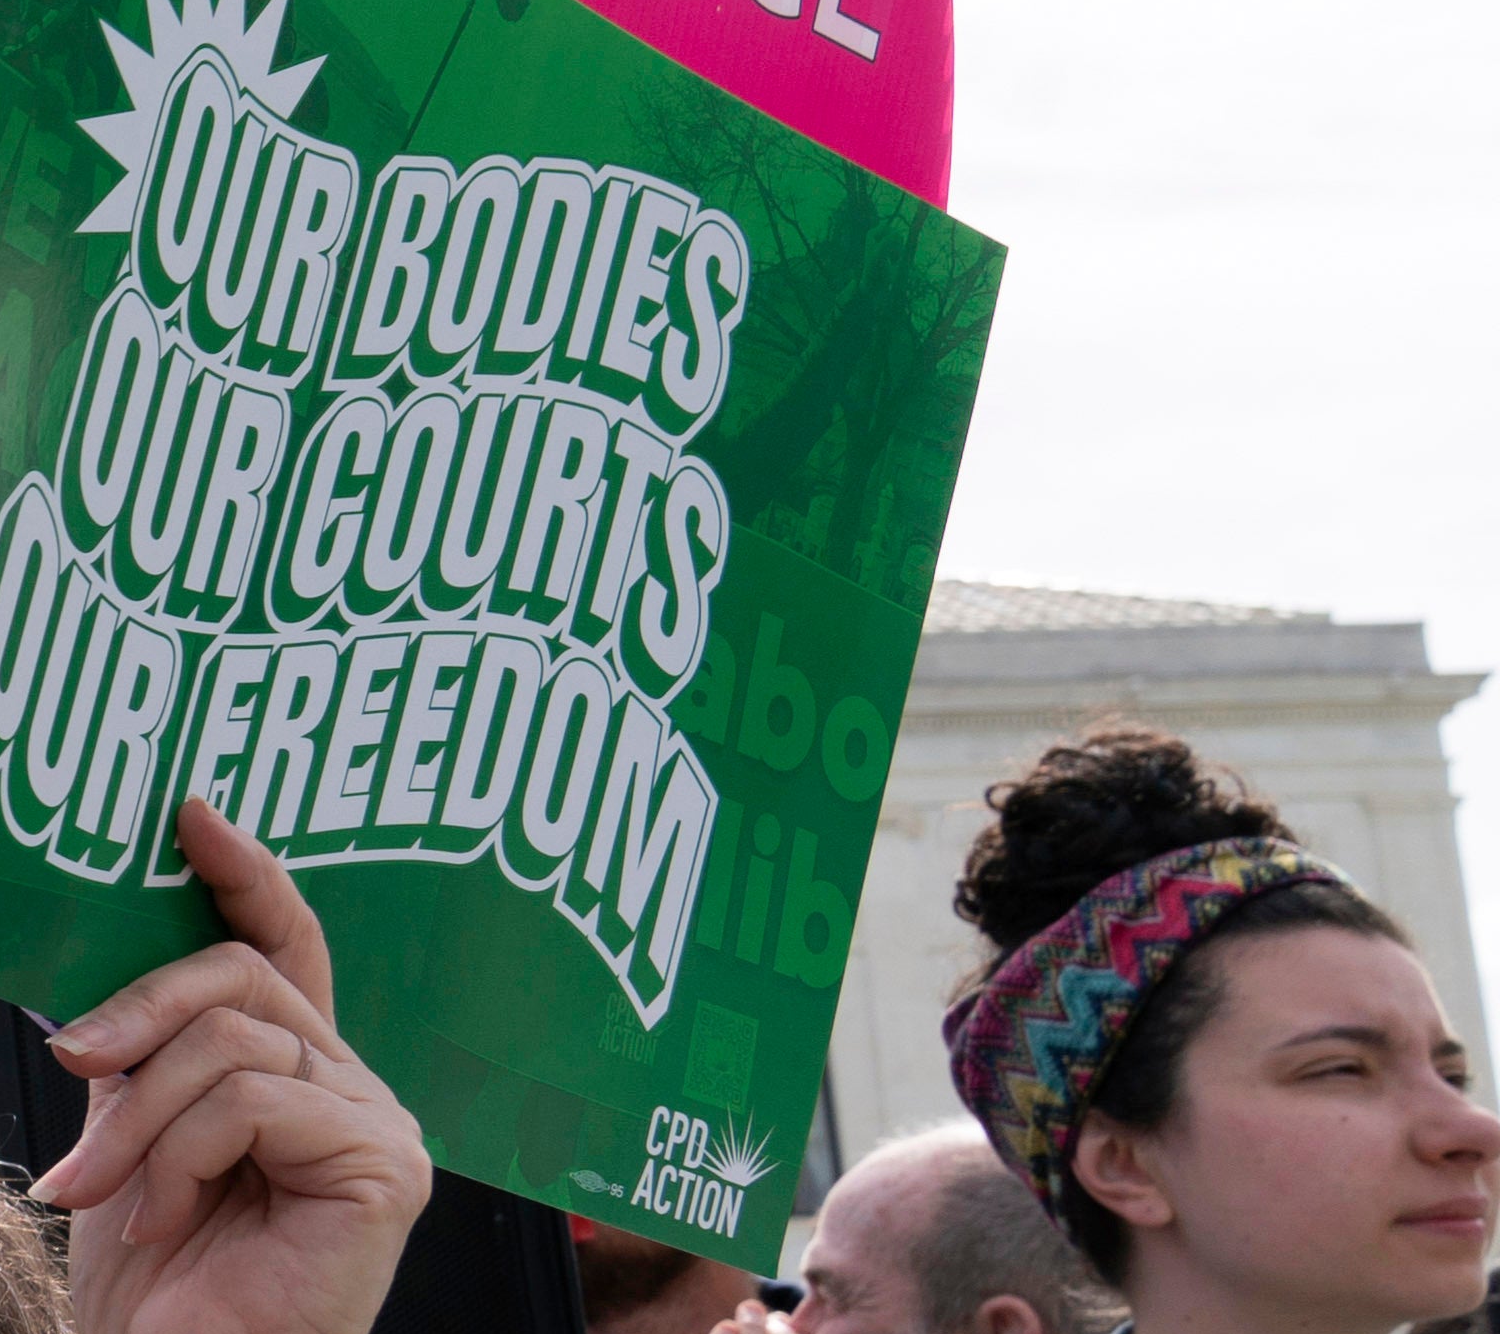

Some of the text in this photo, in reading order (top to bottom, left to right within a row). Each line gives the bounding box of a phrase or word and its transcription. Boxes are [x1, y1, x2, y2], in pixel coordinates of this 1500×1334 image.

[138, 65, 356, 375] OUR
[332, 163, 744, 437] BODIES
[62, 297, 722, 691] OUR COURTS
[152, 635, 714, 1013] FREEDOM
[609, 1183, 624, 1198] 95
[630, 1158, 745, 1239] ACTION
[645, 1105, 709, 1169] CPD
